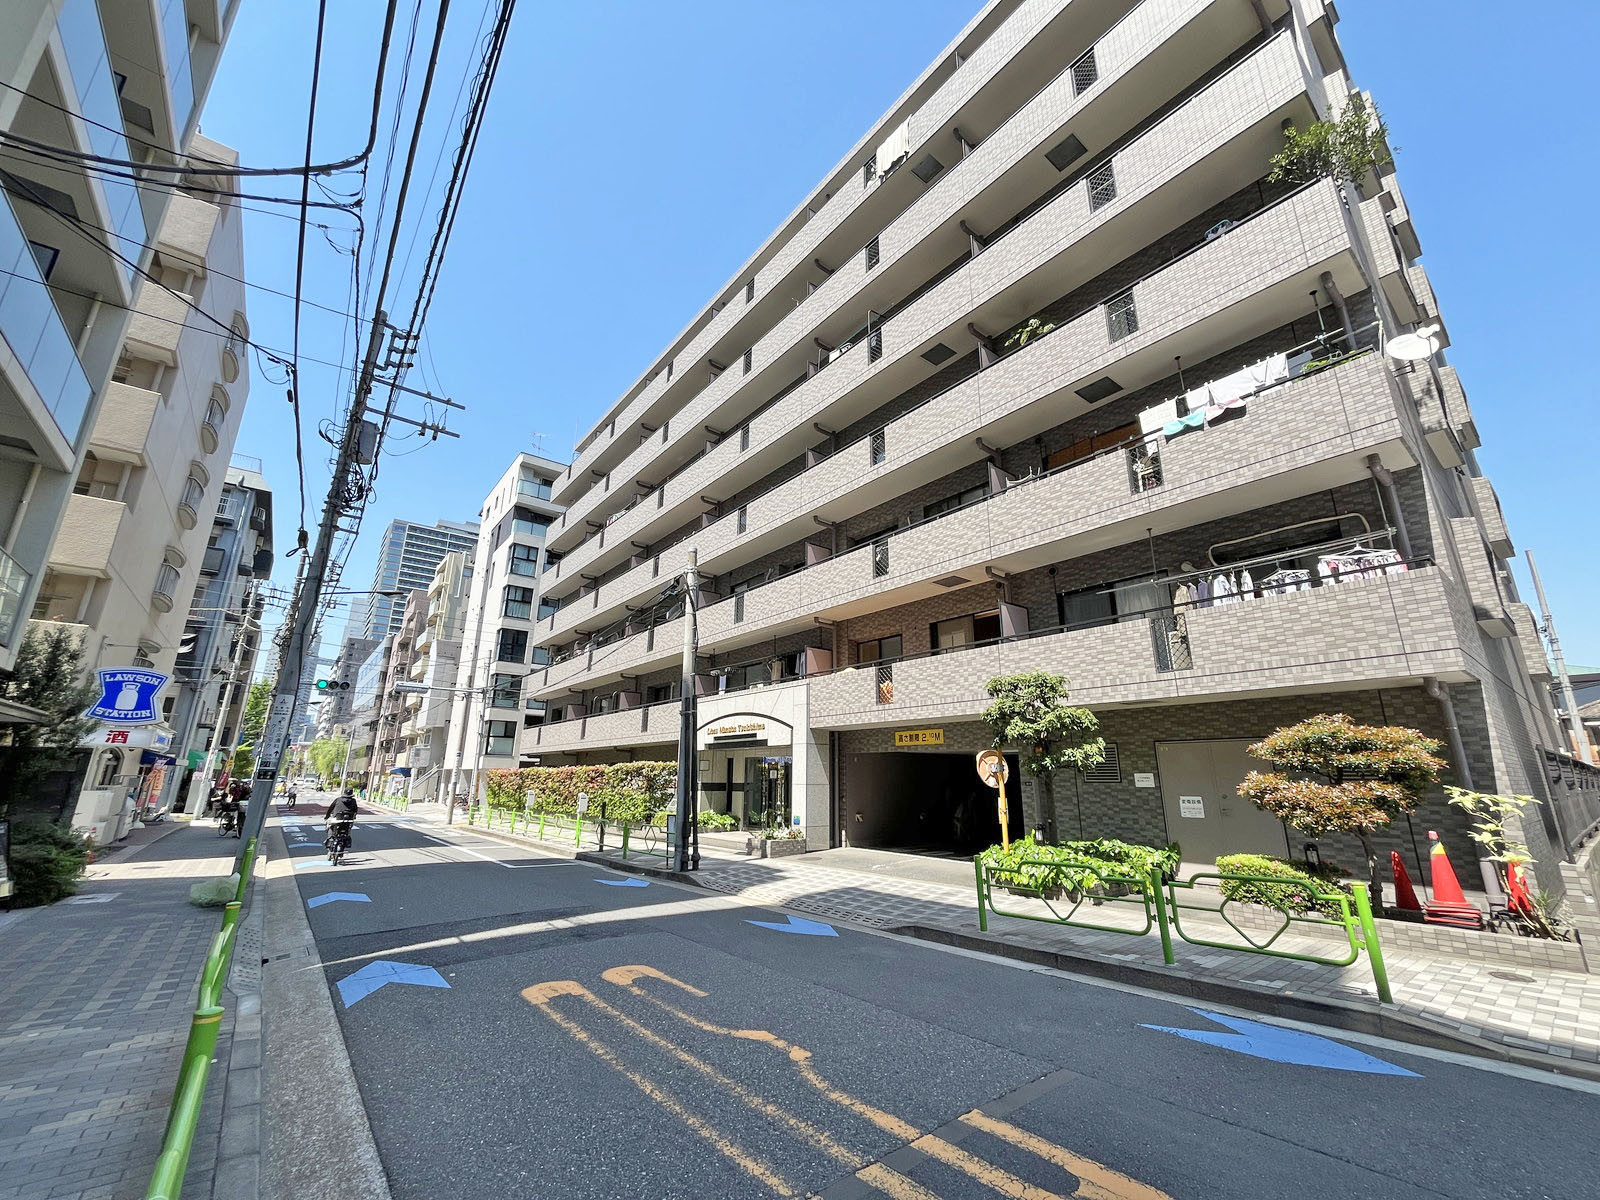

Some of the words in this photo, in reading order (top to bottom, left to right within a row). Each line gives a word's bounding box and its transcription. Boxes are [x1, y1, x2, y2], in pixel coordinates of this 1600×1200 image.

[104, 673, 161, 685] LAWSON
[94, 707, 152, 719] STATION
[104, 729, 130, 744] 酒
